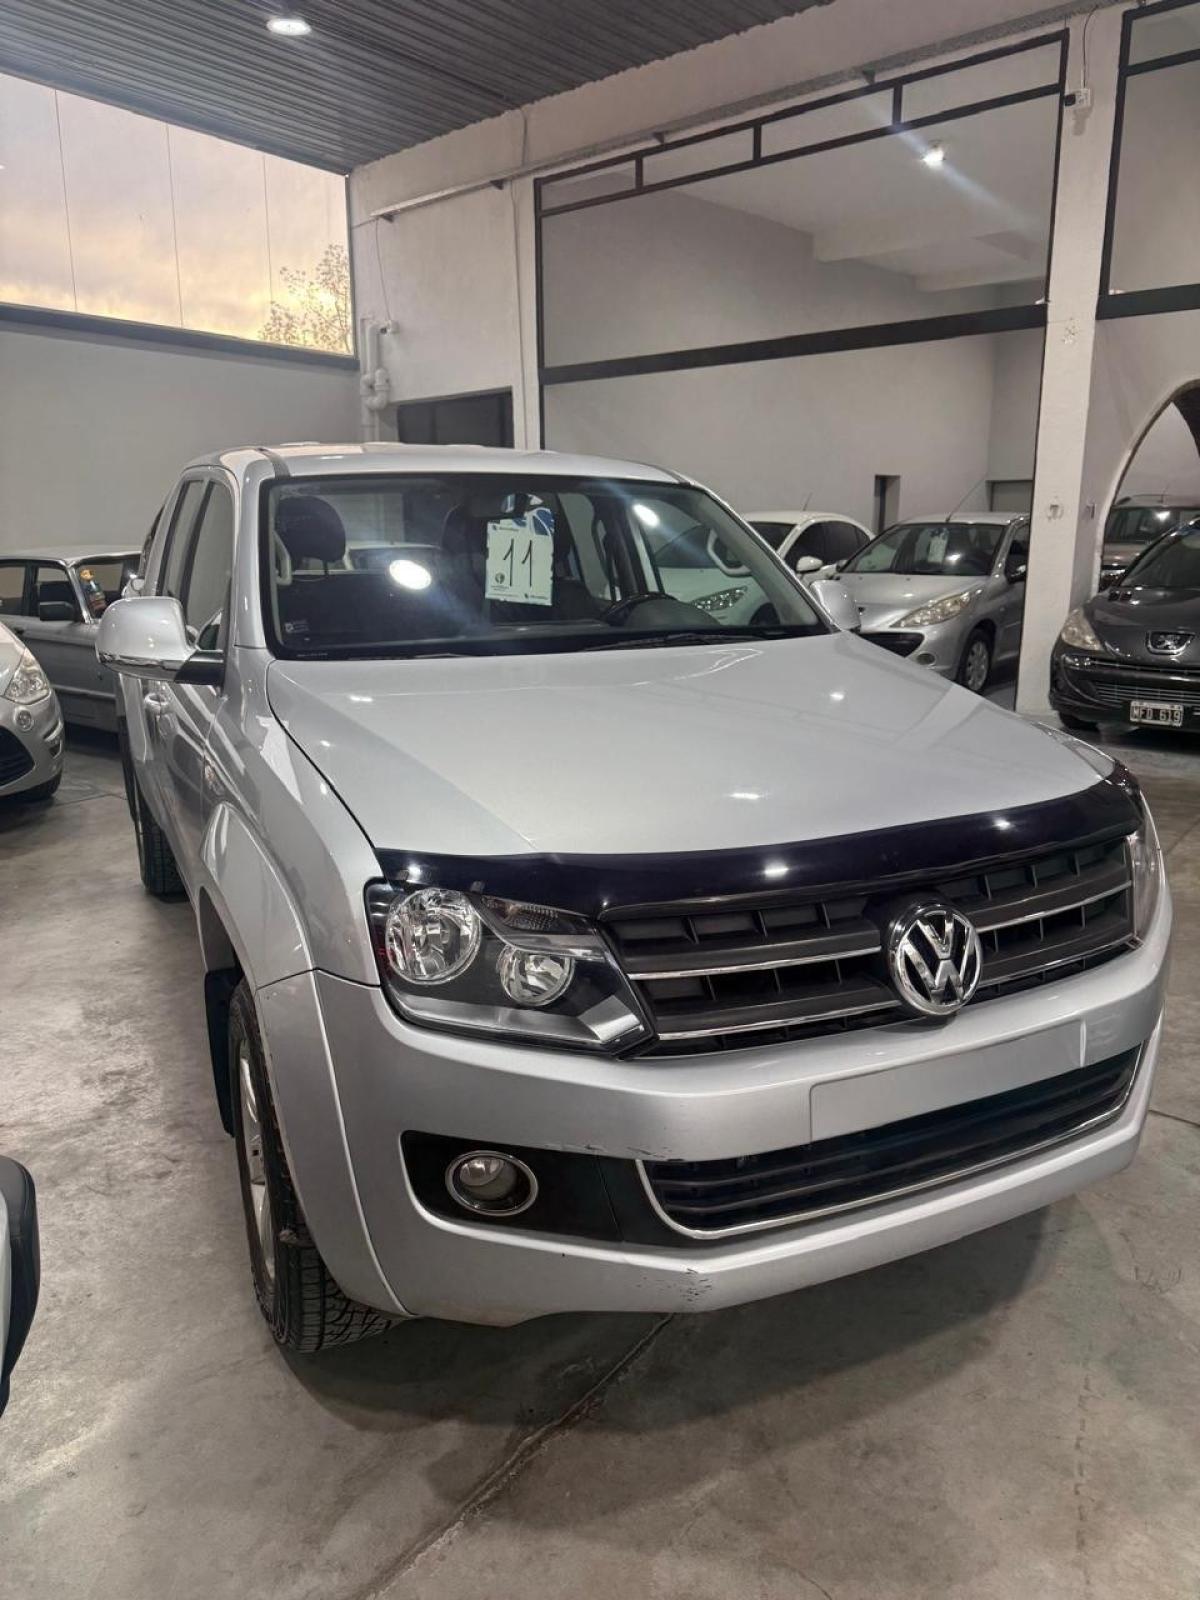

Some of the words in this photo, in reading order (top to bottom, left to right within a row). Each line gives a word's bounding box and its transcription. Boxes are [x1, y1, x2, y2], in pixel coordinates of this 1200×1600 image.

[503, 538, 532, 587] 11
[1159, 708, 1181, 723] 619
[895, 908, 981, 1012] VW
